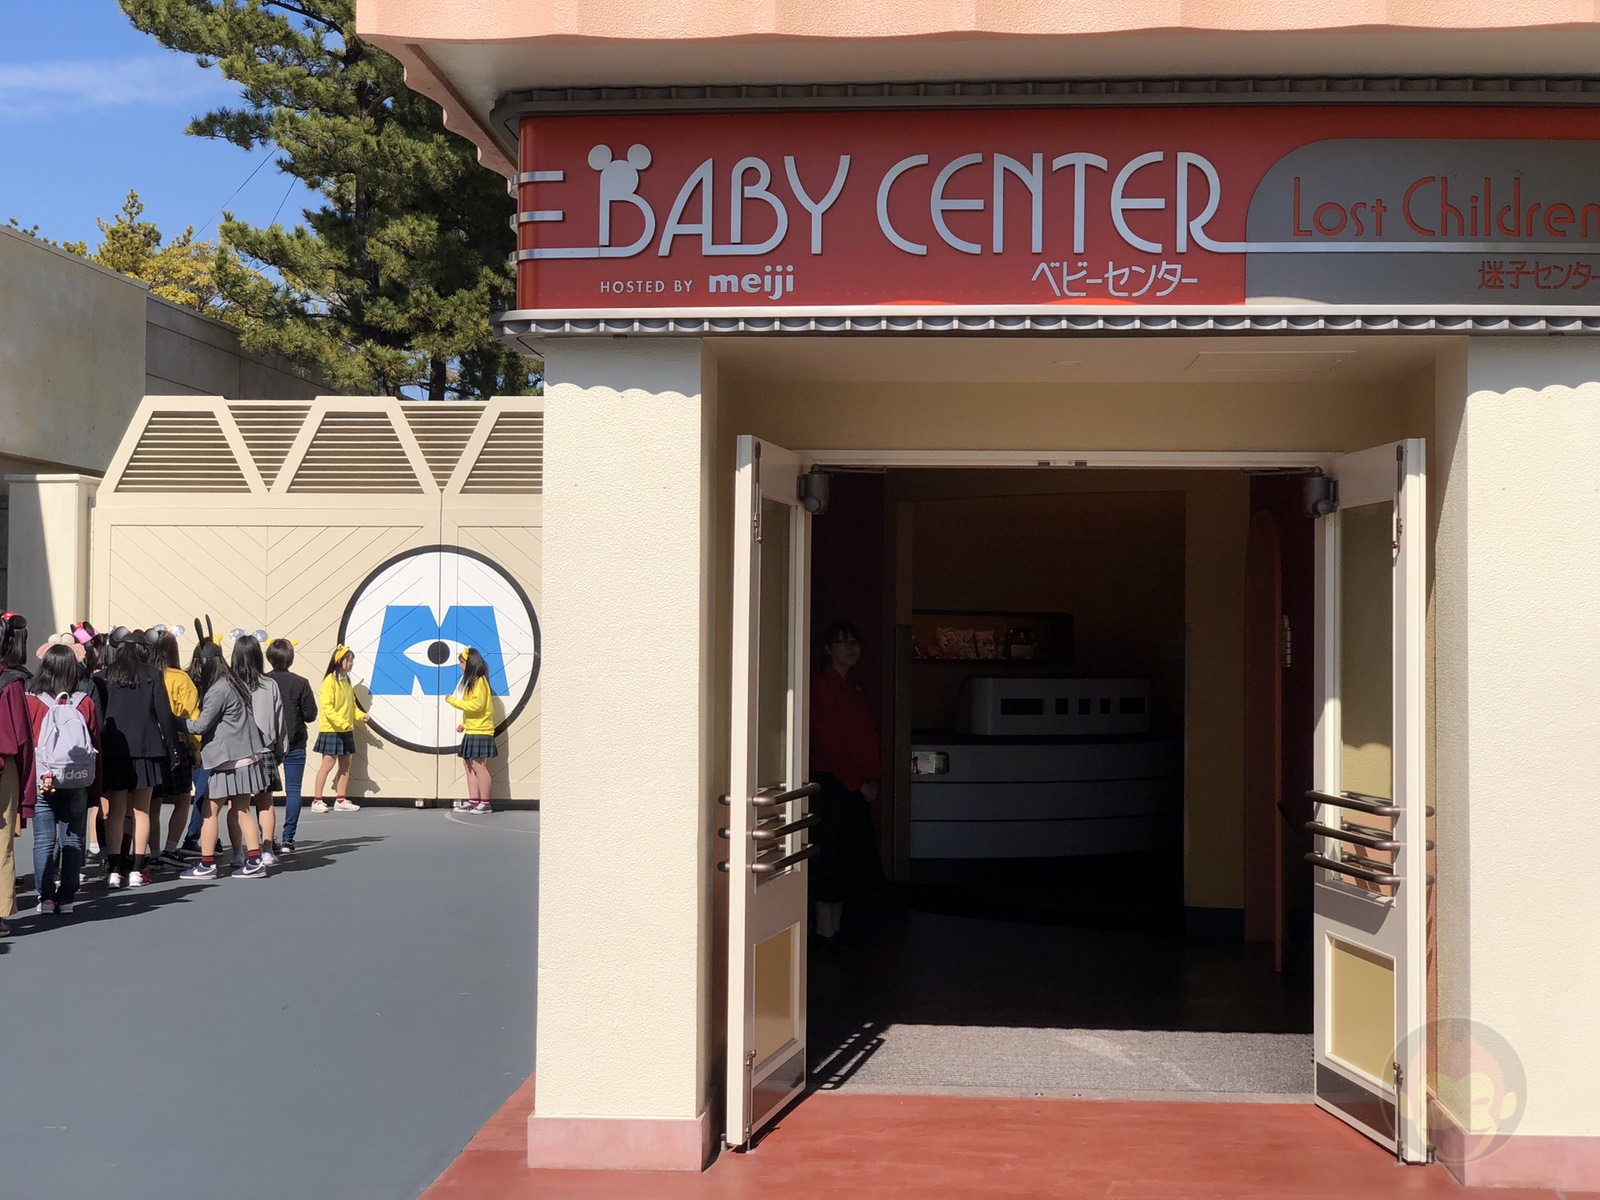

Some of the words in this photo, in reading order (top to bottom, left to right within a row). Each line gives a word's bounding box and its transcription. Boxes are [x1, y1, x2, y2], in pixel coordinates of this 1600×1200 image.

[588, 144, 850, 257] BABY
[876, 151, 1247, 255] CENTER
[1293, 176, 1387, 238] Lost
[1402, 175, 1600, 238] Children
[600, 280, 665, 294] HOSTED
[674, 279, 693, 293] BY
[708, 264, 795, 300] meiji
[1031, 260, 1198, 297] ベビーセンター
